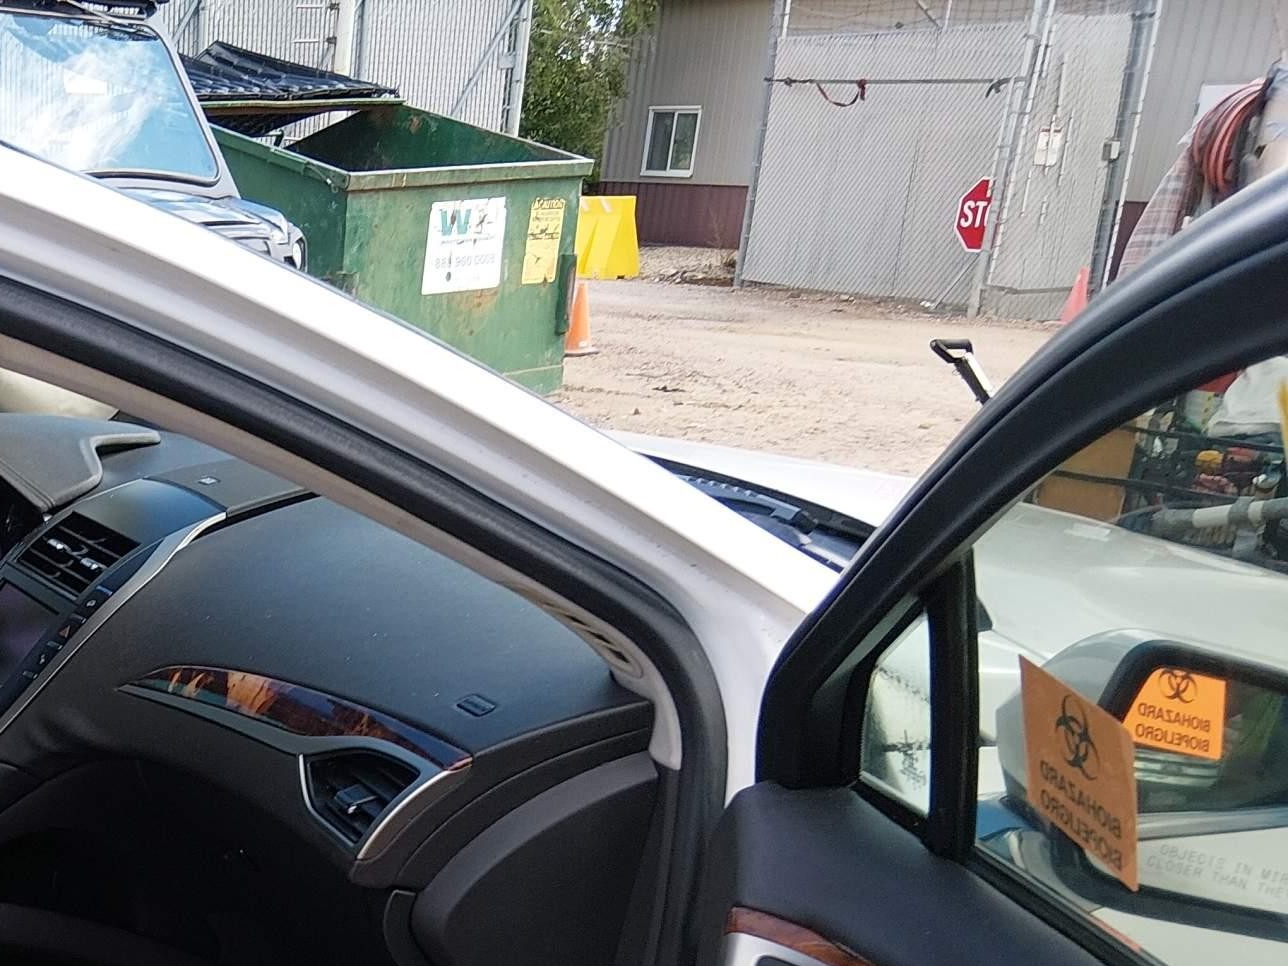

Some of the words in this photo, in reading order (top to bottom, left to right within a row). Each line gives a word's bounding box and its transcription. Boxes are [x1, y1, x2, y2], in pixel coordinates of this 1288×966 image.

[960, 199, 992, 228] ST
[1146, 855, 1202, 878] CLOSER
[1213, 871, 1248, 890] THAN
[1159, 844, 1227, 870] OBJECTS
[1235, 861, 1253, 876] IN
